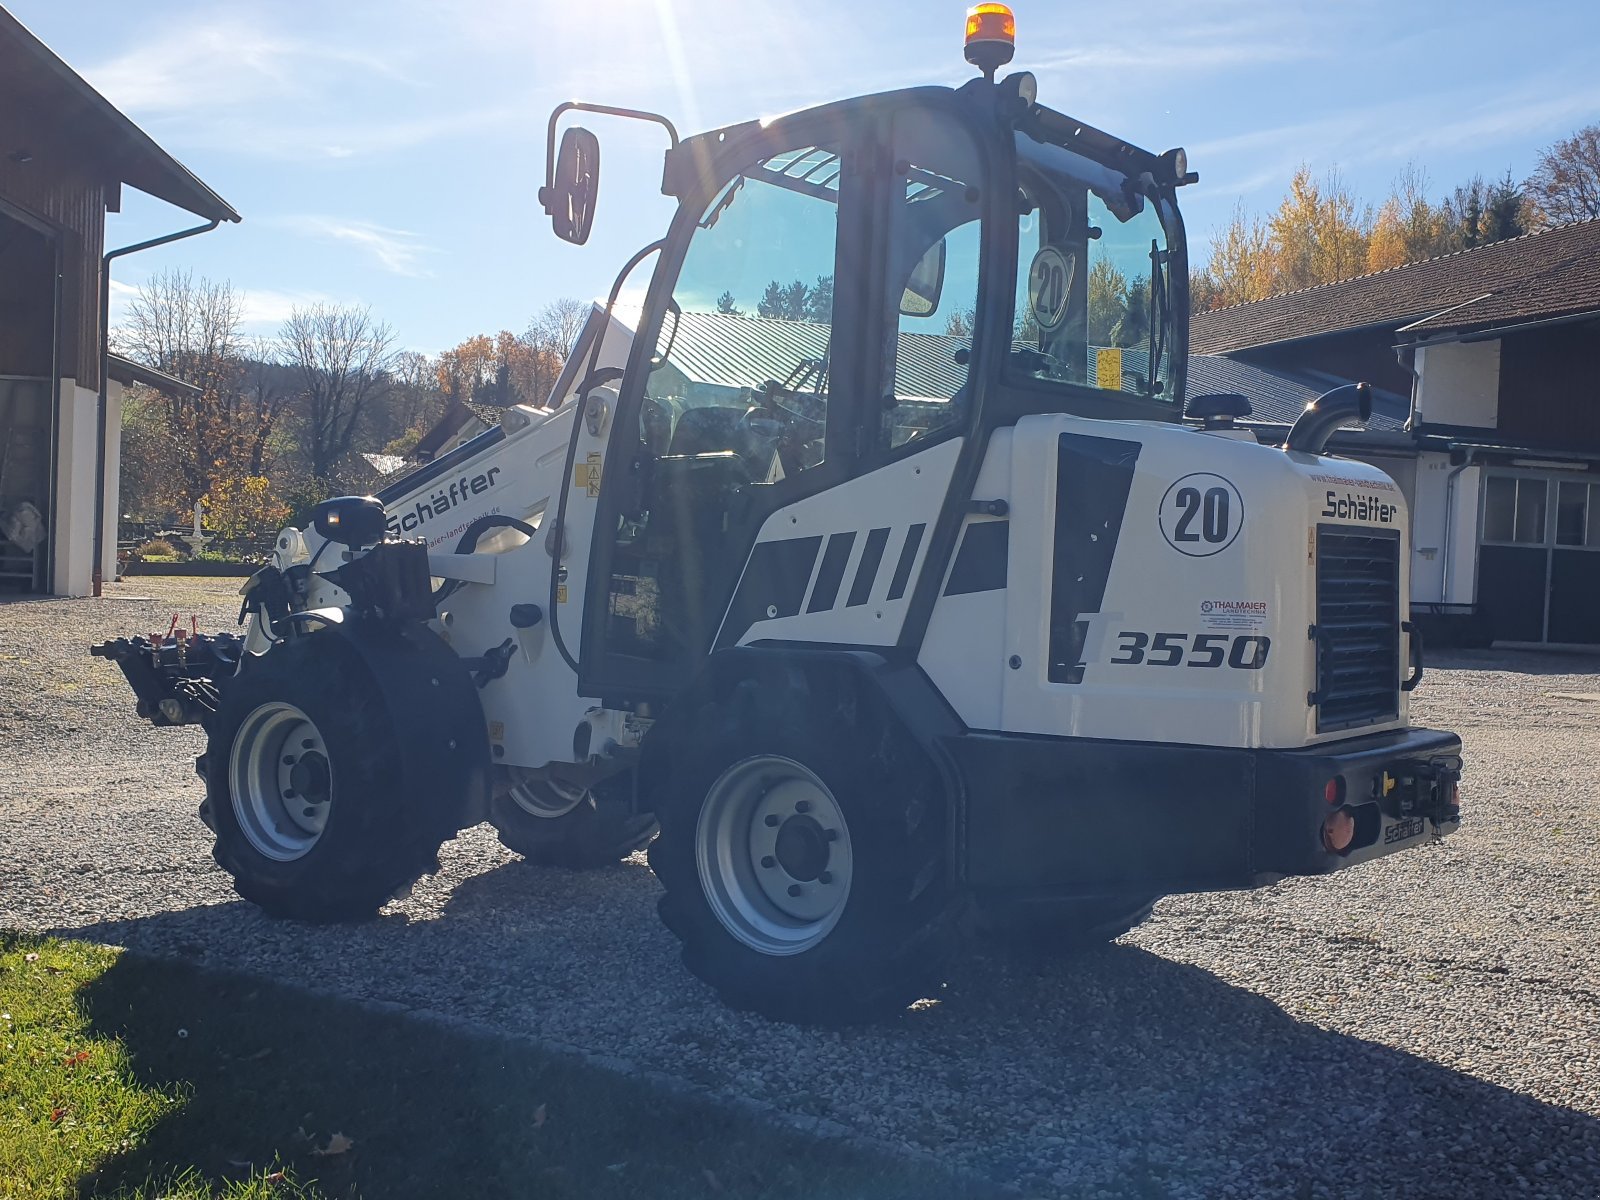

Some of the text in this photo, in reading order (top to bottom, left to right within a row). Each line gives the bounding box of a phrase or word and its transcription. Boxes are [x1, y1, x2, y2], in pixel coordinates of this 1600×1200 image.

[1036, 261, 1063, 317] 20
[1174, 486, 1230, 543] 20
[1322, 491, 1397, 523] Schäffer
[1213, 601, 1267, 610] THALMAIER
[1110, 631, 1272, 670] 3550
